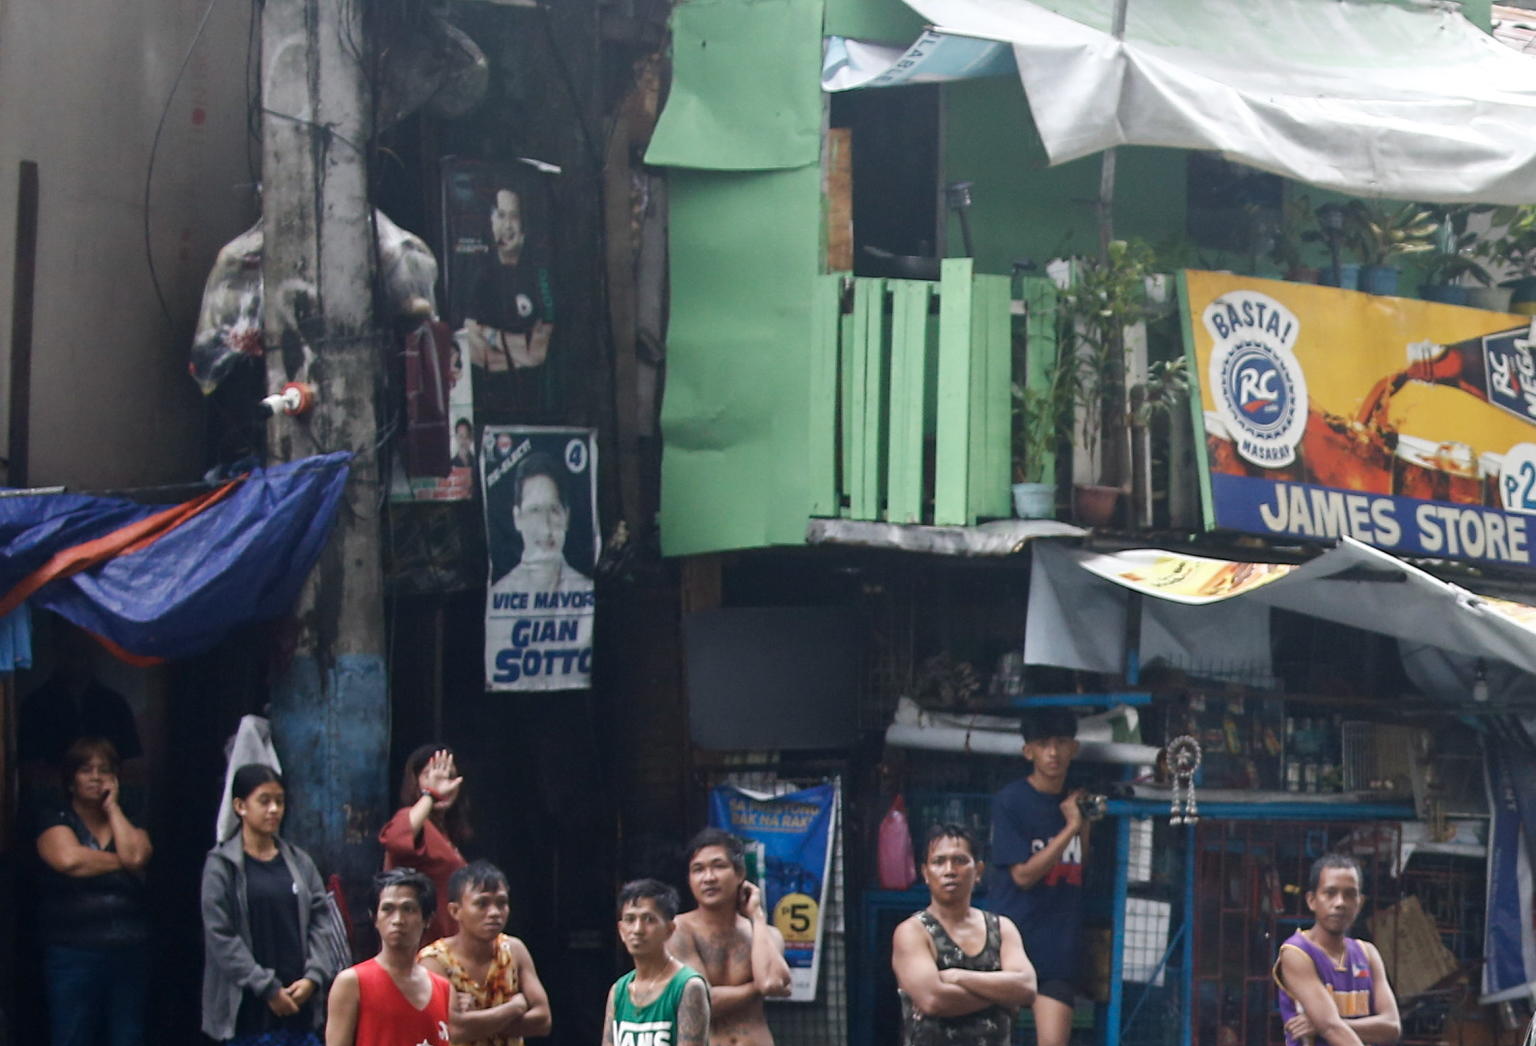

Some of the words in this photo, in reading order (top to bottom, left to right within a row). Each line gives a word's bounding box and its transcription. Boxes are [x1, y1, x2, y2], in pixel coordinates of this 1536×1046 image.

[1212, 300, 1292, 344] BASTA!
[1239, 367, 1279, 406] RC
[1489, 351, 1518, 398] RC
[569, 444, 582, 467] 4
[1260, 483, 1401, 547] JAMES
[1416, 504, 1529, 563] STORE
[493, 592, 528, 610] VICE
[512, 619, 578, 649] GIAN
